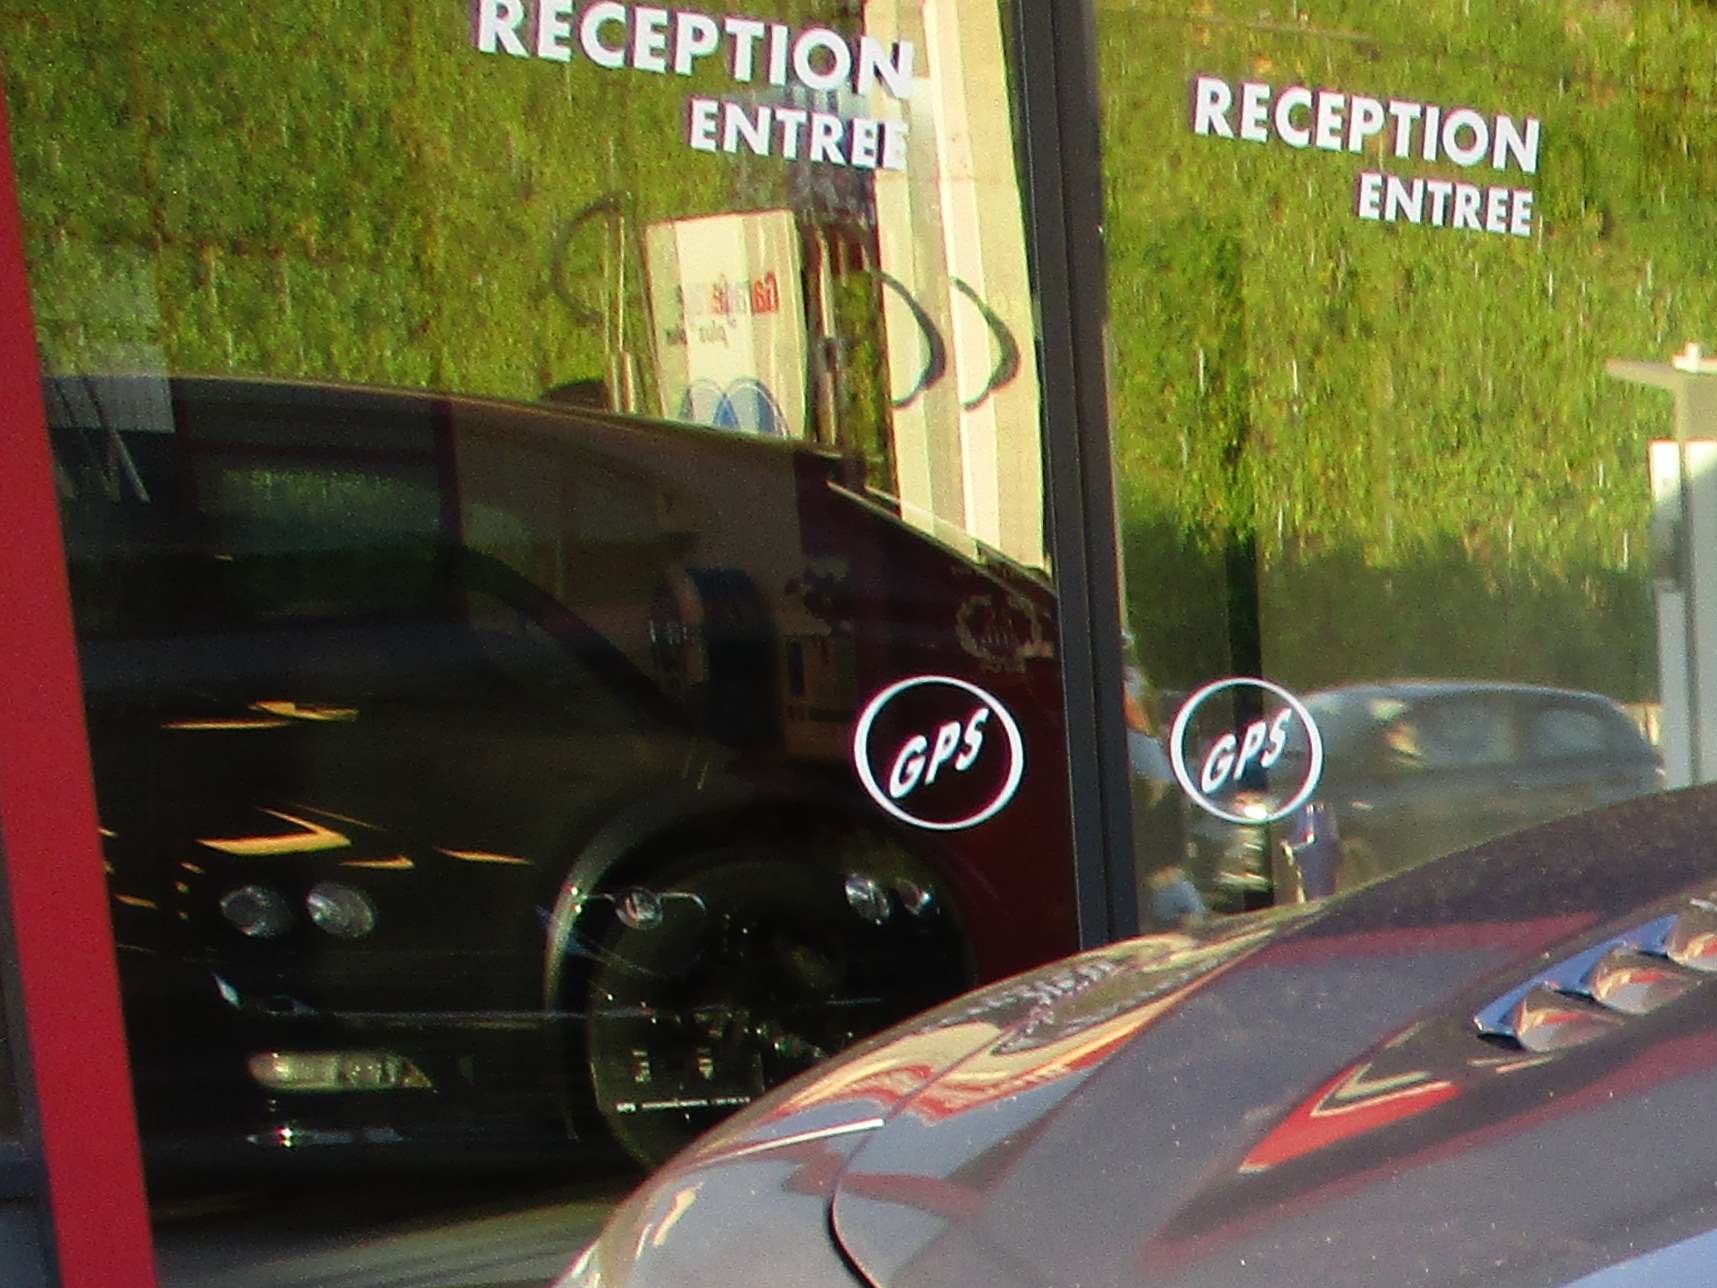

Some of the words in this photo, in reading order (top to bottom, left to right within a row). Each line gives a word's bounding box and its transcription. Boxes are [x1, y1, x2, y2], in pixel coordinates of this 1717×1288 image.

[477, 0, 914, 99] RECEPTION
[689, 97, 909, 171] ENTREE
[1193, 74, 1540, 174] RECEPTION
[1357, 170, 1534, 237] ENTREE
[889, 707, 990, 799] GPS
[1200, 707, 1293, 794] GPS
